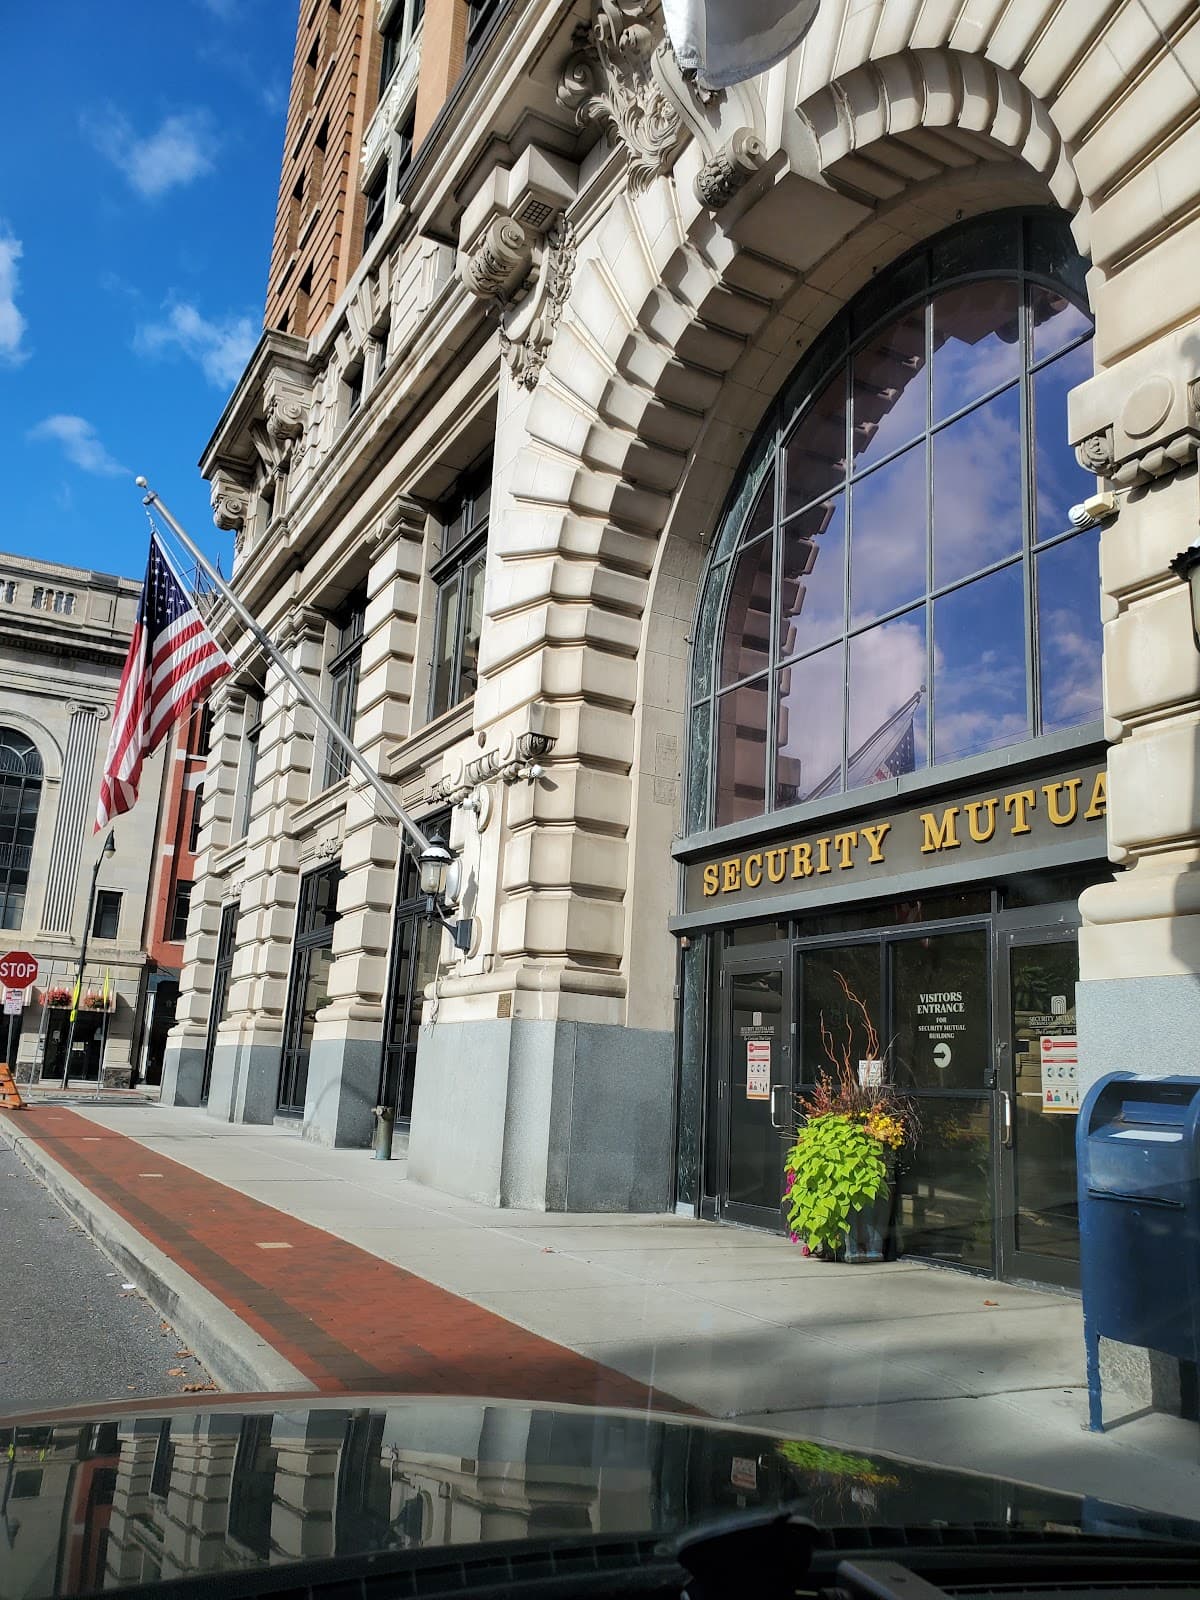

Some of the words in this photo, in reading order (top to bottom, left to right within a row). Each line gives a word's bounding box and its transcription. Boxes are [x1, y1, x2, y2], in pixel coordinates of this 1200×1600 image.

[703, 823, 892, 897] SECURITY
[920, 778, 1107, 853] MUTUA
[0, 962, 36, 978] STOP
[919, 992, 962, 1004] VISITORS
[917, 1003, 965, 1014] ENTRANCE
